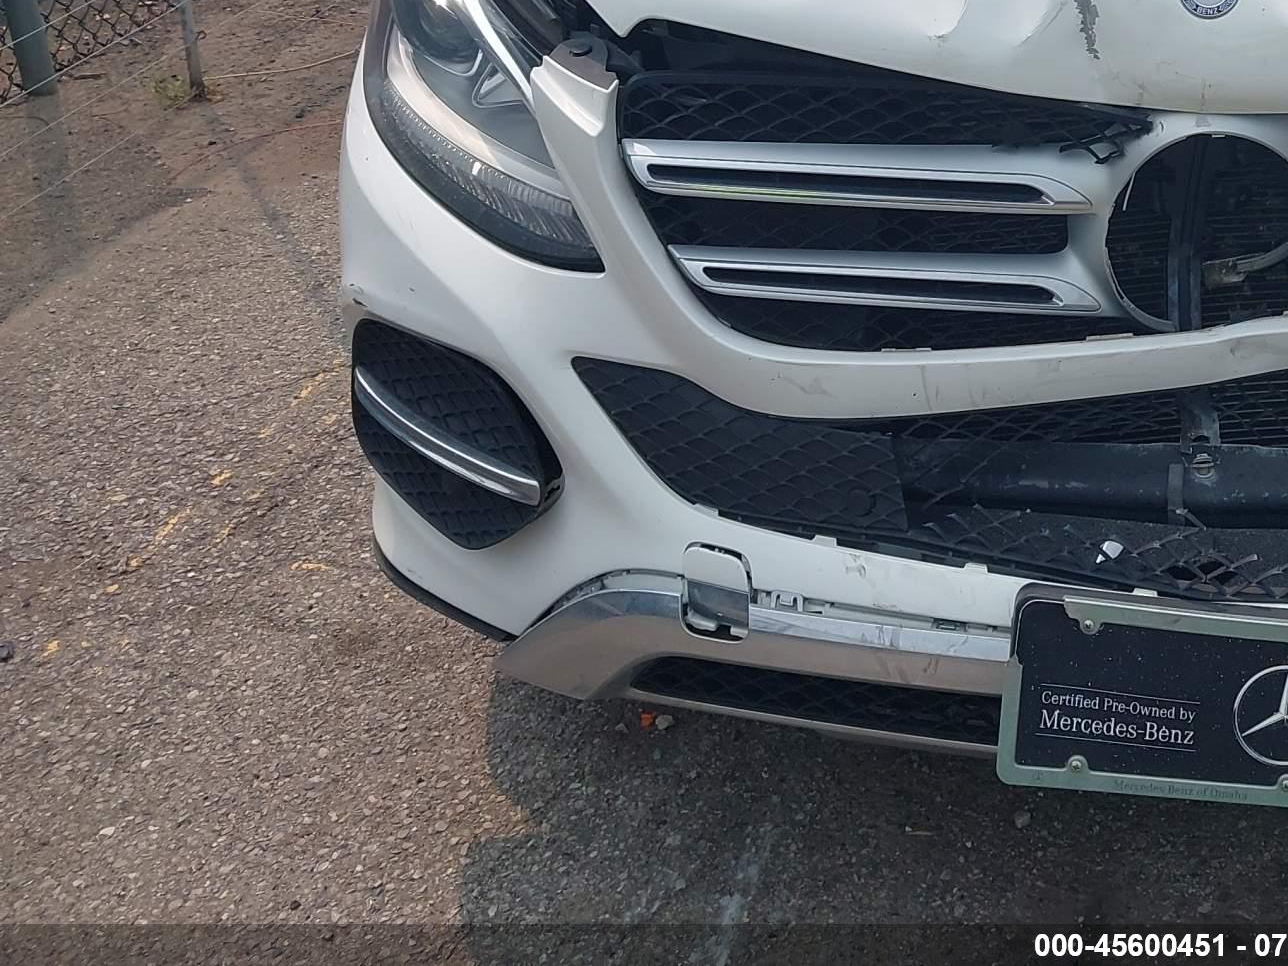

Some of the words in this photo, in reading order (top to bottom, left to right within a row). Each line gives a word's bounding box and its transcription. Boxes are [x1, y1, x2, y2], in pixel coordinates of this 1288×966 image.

[1197, 7, 1219, 15] BENZ
[1041, 691, 1100, 709] Certified
[1104, 698, 1176, 719] Pre-Owned
[1179, 707, 1196, 724] by
[1039, 709, 1195, 745] Mercedes-Benz
